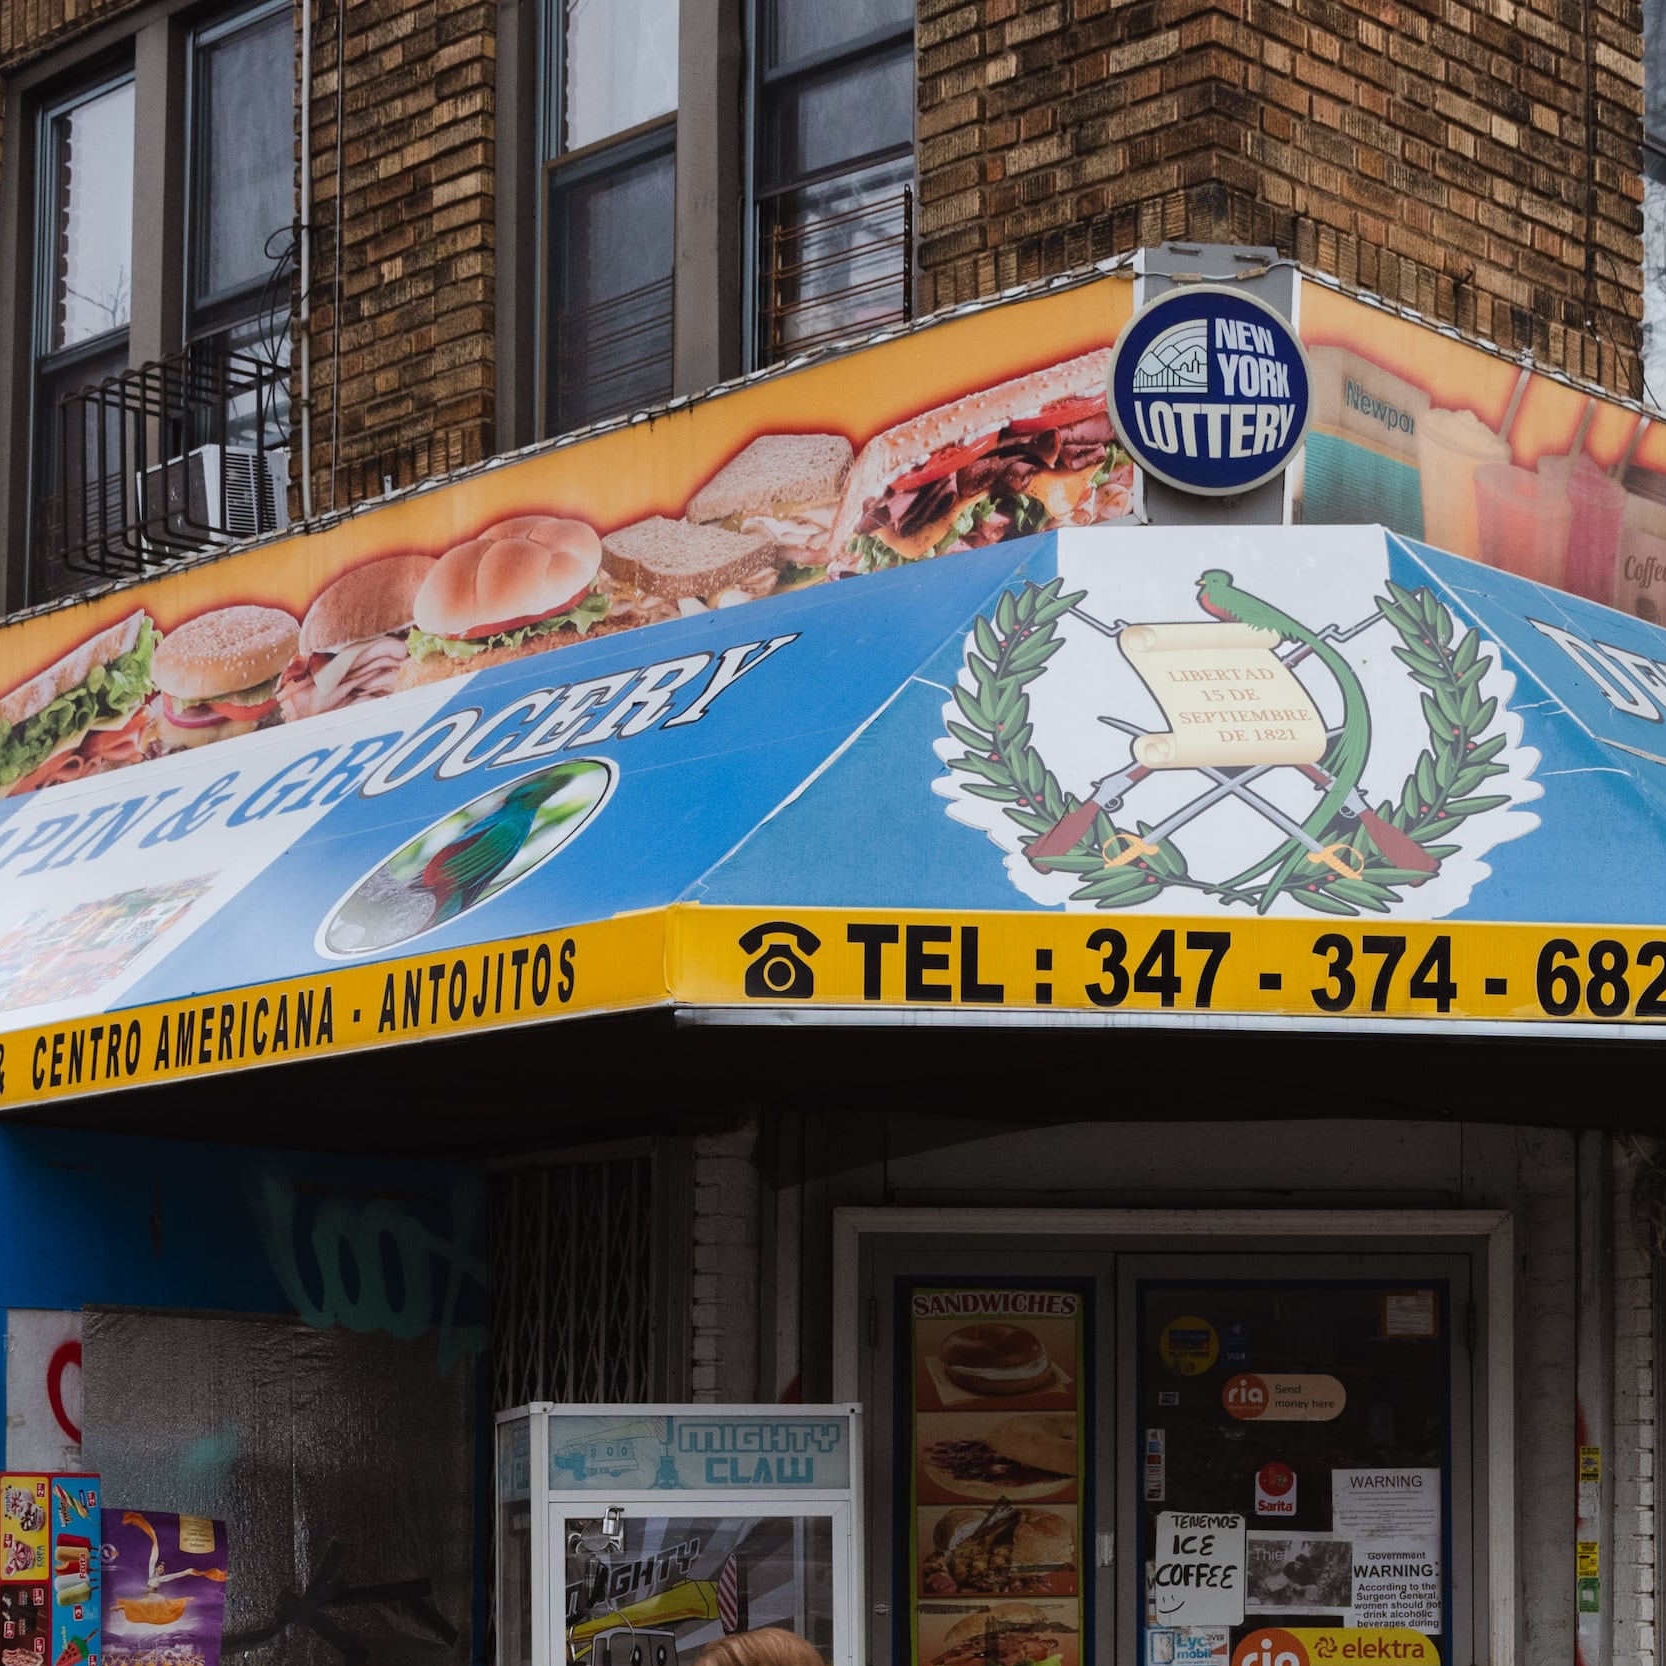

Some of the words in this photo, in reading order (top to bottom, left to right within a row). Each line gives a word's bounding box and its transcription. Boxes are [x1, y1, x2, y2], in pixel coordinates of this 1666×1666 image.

[1215, 318, 1275, 356] NEW
[1216, 353, 1291, 398] YORK
[1134, 400, 1296, 459] LOTTERY
[1167, 668, 1275, 682] LIBERTAD
[1200, 689, 1225, 701] 15
[1228, 688, 1260, 701] DE
[1179, 709, 1312, 724] SEPTIEMBRE
[142, 771, 242, 845] &
[227, 632, 803, 828] GROCERY
[1217, 730, 1249, 742] DE
[1253, 729, 1299, 741] 1821
[1085, 927, 1232, 1010] 347
[1310, 933, 1459, 1014] 374
[33, 1020, 141, 1090] CENTRO
[154, 985, 334, 1073] AMERICANA
[378, 938, 577, 1033] ANTOJITOS
[913, 1291, 1076, 1317] SANDWICHES
[1228, 1379, 1264, 1403] ria
[1275, 1383, 1301, 1396] Send
[1275, 1399, 1310, 1411] money
[1312, 1398, 1335, 1409] here
[678, 1423, 840, 1453] MIGHTY
[705, 1456, 814, 1484] CLAW
[1350, 1475, 1422, 1488] WARNING
[1257, 1499, 1293, 1513] Sarita
[1171, 1514, 1240, 1529] TENEMOS
[1173, 1534, 1215, 1556] ICE
[1368, 1551, 1426, 1560] Government
[1156, 1563, 1238, 1589] COFFEE
[1354, 1561, 1439, 1578] WARNING:
[1358, 1583, 1407, 1594] According
[1409, 1583, 1419, 1591] to
[1421, 1582, 1437, 1591] the
[1354, 1602, 1388, 1610] women
[1391, 1600, 1423, 1609] should
[1356, 1592, 1396, 1603] Surgeon
[1363, 1610, 1387, 1618] drink
[1390, 1610, 1433, 1618] alcoholic
[1357, 1620, 1405, 1629] beverages
[1408, 1619, 1439, 1629] during
[1342, 1636, 1425, 1659] elektra
